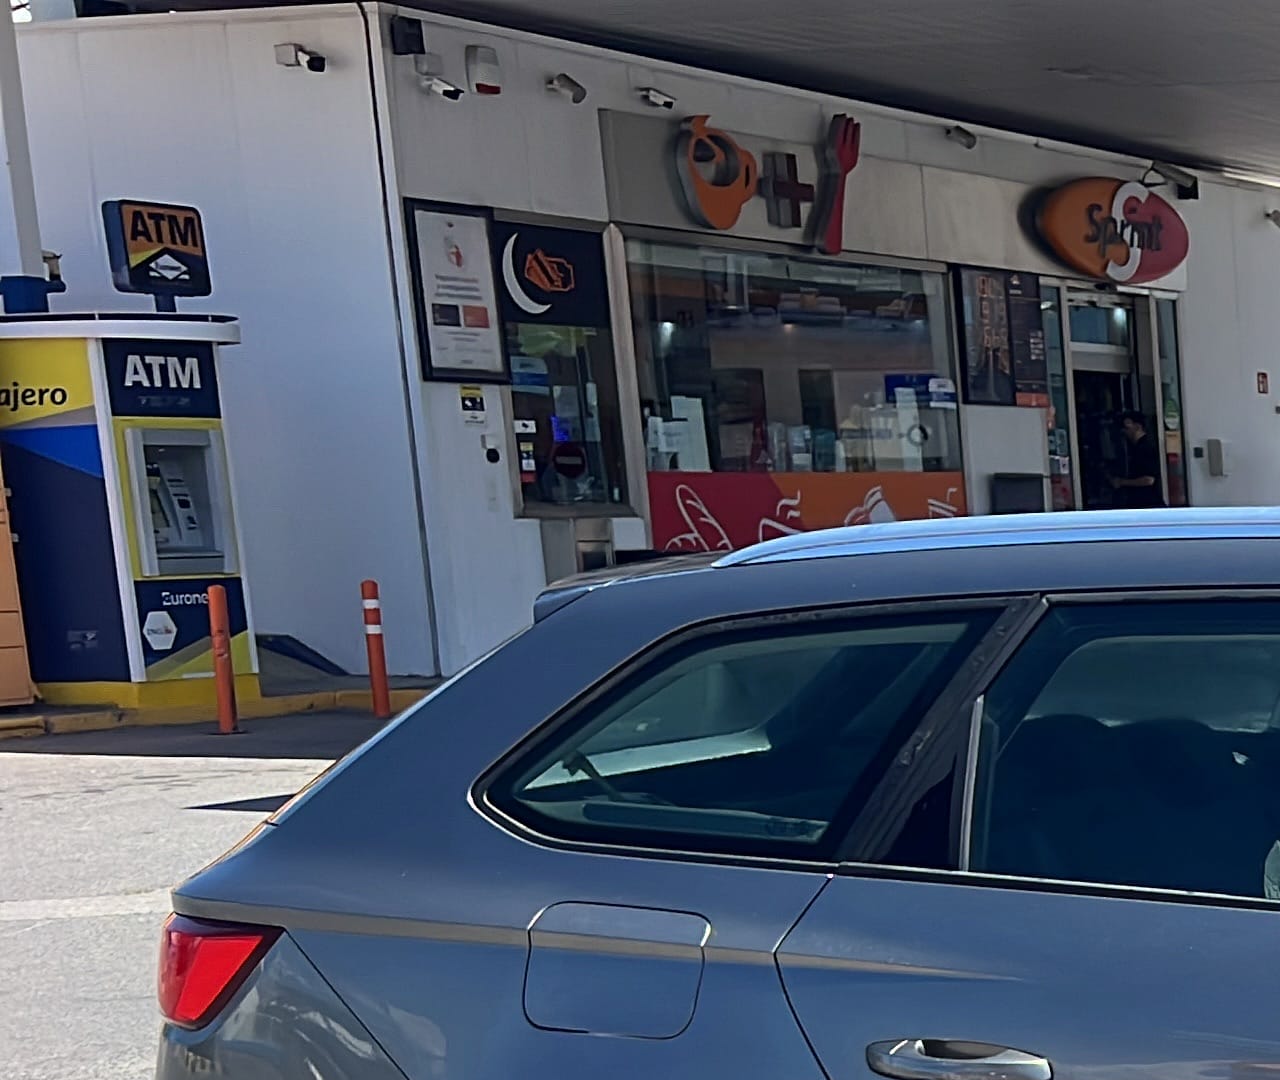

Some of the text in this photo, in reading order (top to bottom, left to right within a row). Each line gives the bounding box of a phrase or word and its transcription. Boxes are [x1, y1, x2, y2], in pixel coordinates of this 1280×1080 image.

[131, 210, 199, 248] ATM
[1084, 203, 1163, 258] Sprint
[124, 355, 201, 389] ATM
[161, 591, 209, 606] Eurone
